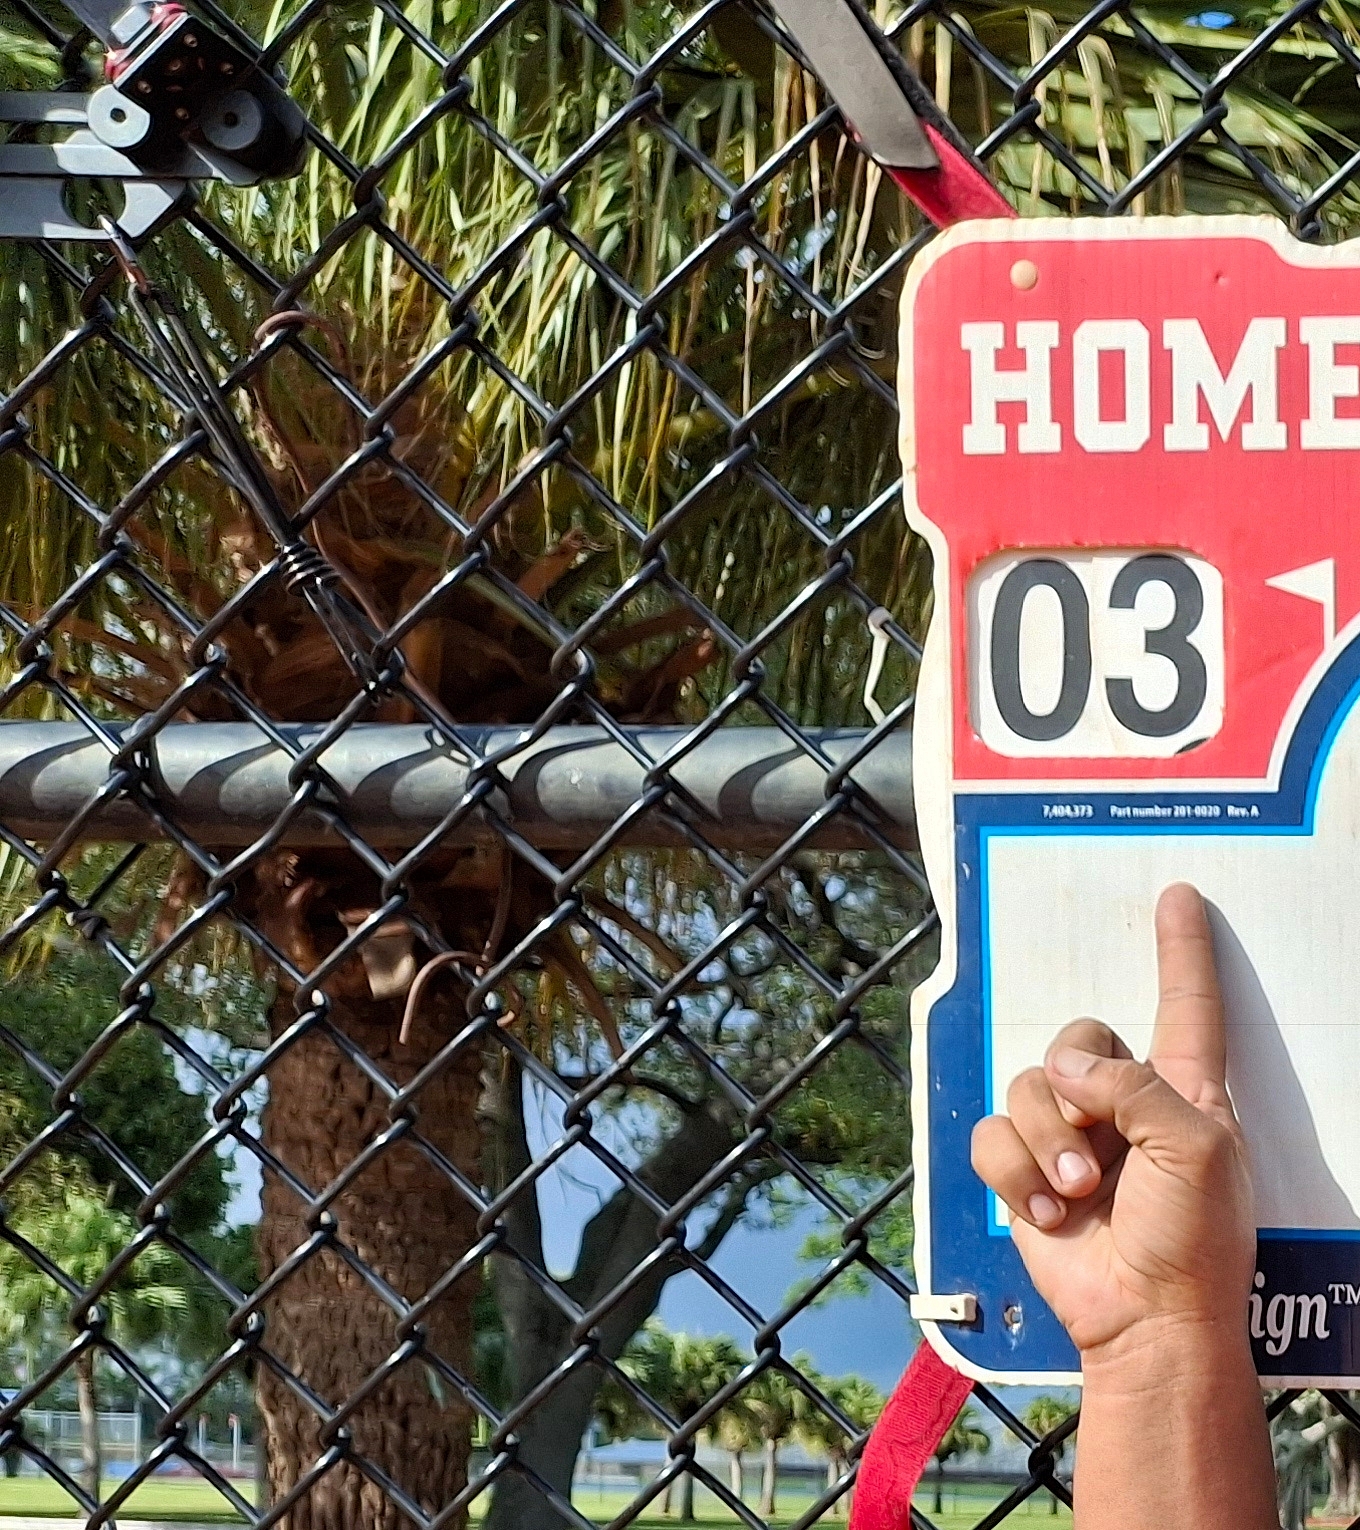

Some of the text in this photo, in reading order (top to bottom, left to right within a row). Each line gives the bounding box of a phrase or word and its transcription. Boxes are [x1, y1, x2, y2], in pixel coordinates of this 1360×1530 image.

[990, 554, 1208, 742] 03
[1110, 804, 1131, 818] Part
[1132, 804, 1172, 818] number
[1250, 804, 1260, 818] A
